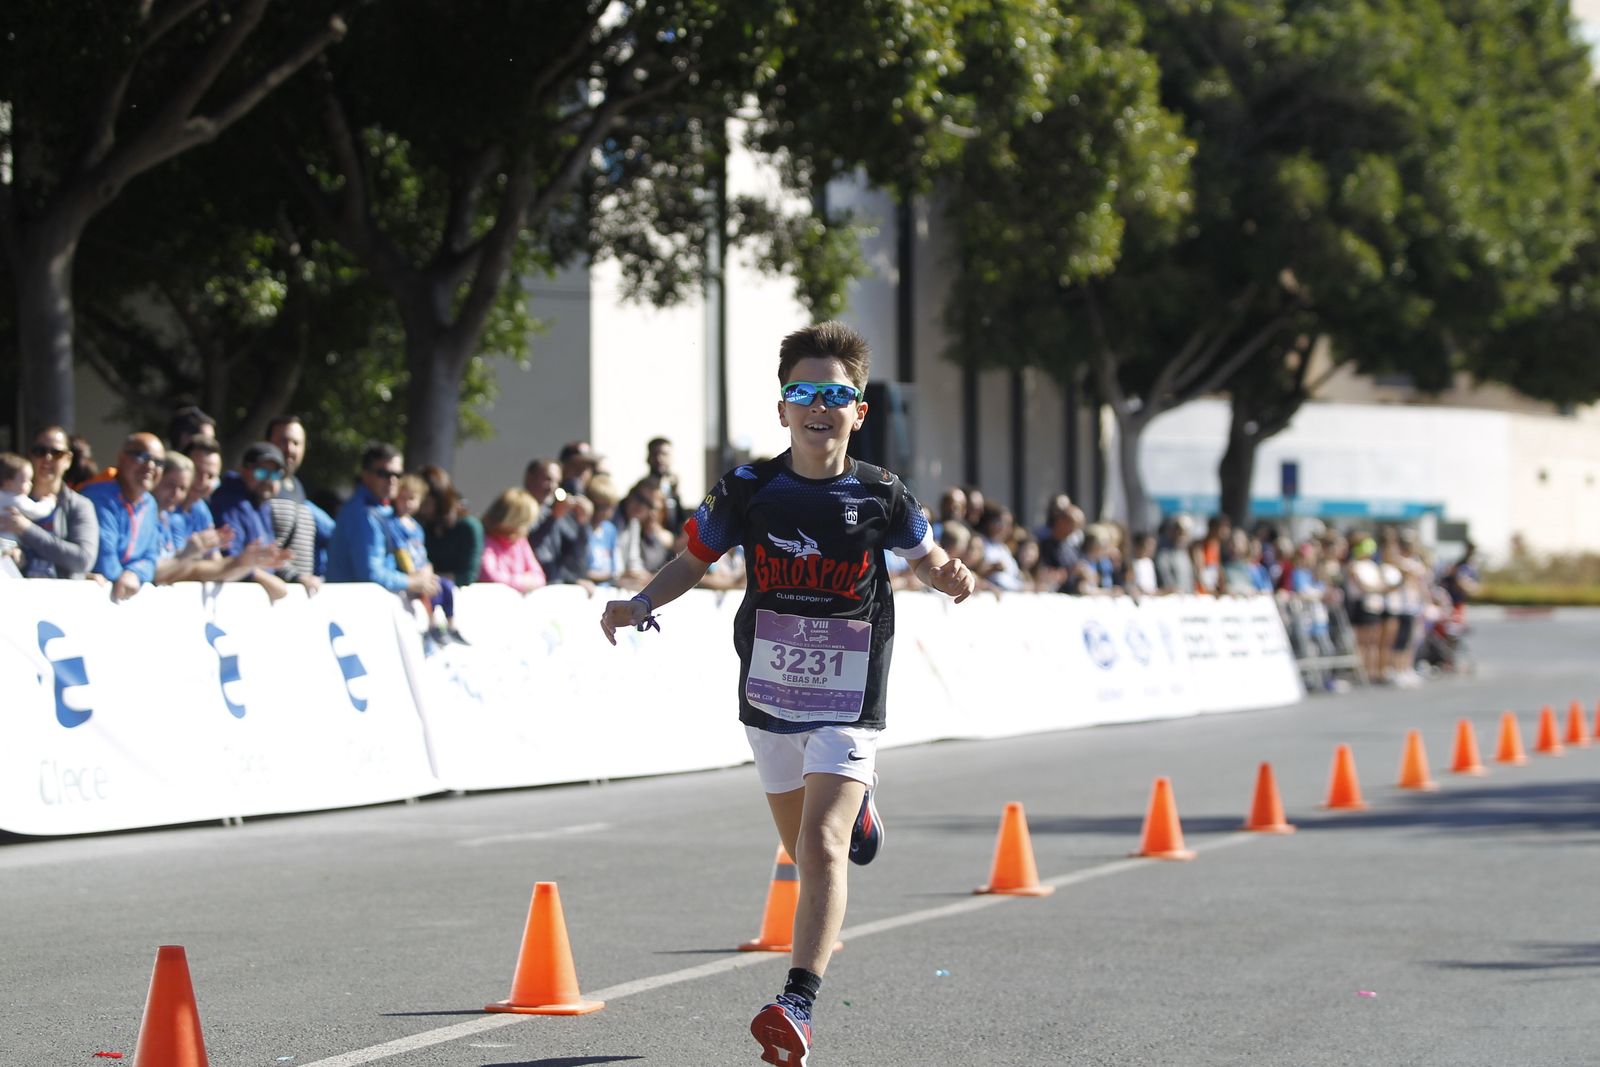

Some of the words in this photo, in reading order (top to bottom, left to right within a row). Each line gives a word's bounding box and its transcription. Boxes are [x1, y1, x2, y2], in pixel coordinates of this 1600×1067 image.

[846, 507, 858, 521] GS
[776, 592, 795, 600] CLUB
[812, 620, 829, 629] VIII
[770, 645, 844, 677] 3231
[781, 673, 810, 684] SEBAS
